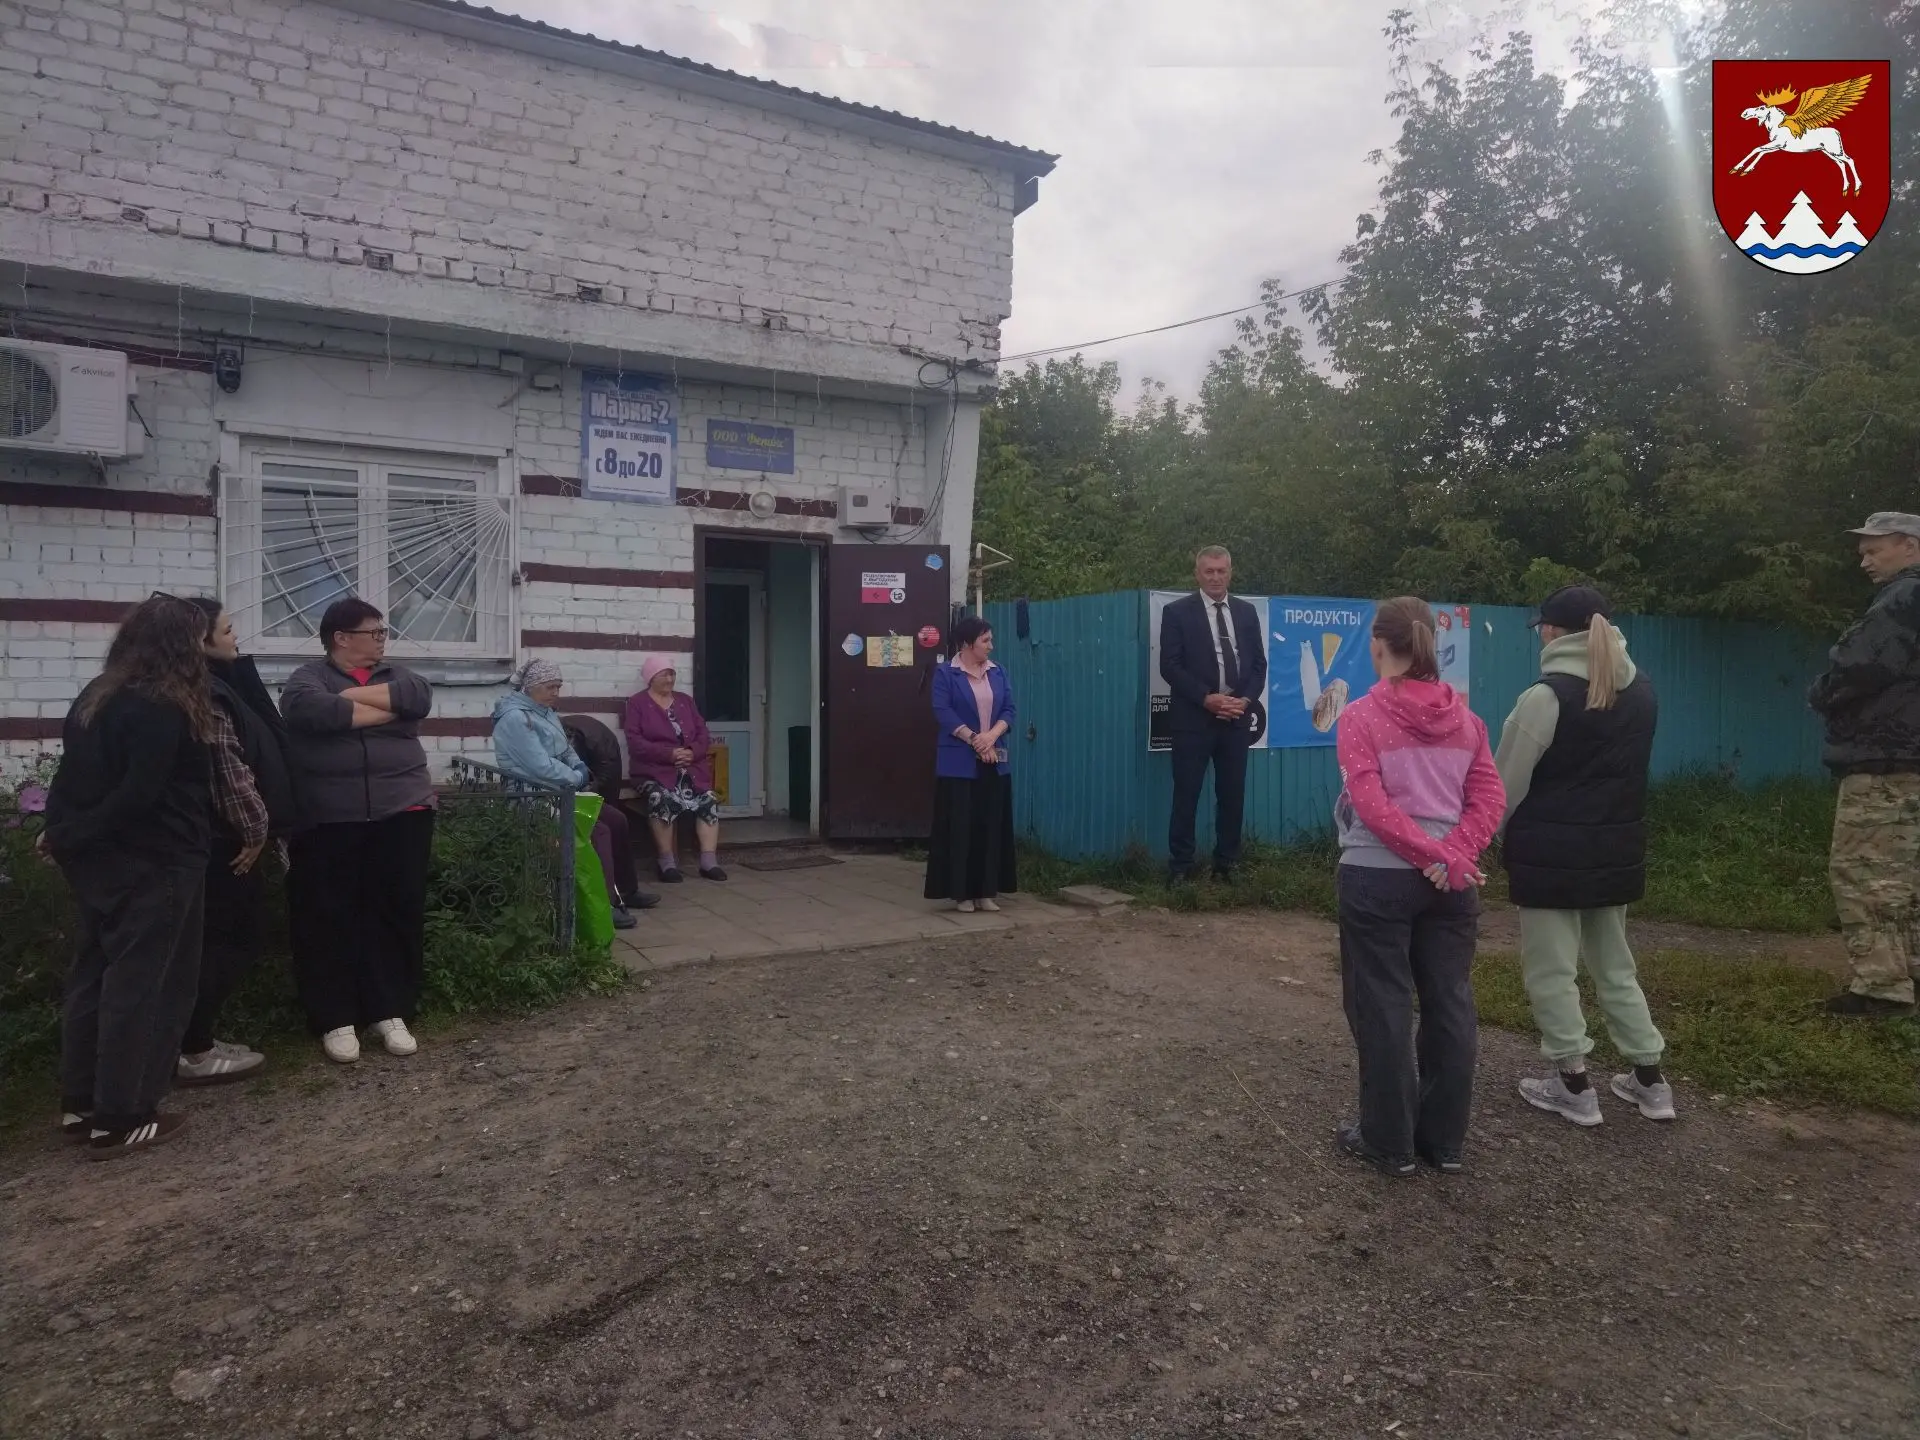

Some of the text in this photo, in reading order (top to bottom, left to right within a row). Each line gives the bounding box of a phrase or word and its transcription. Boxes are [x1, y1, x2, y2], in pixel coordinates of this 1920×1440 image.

[604, 447, 617, 475] 8
[618, 460, 635, 478] до
[636, 451, 663, 479] 20
[1284, 608, 1361, 627] ПРОДУКТЫ
[1151, 704, 1169, 713] ДЛЯ
